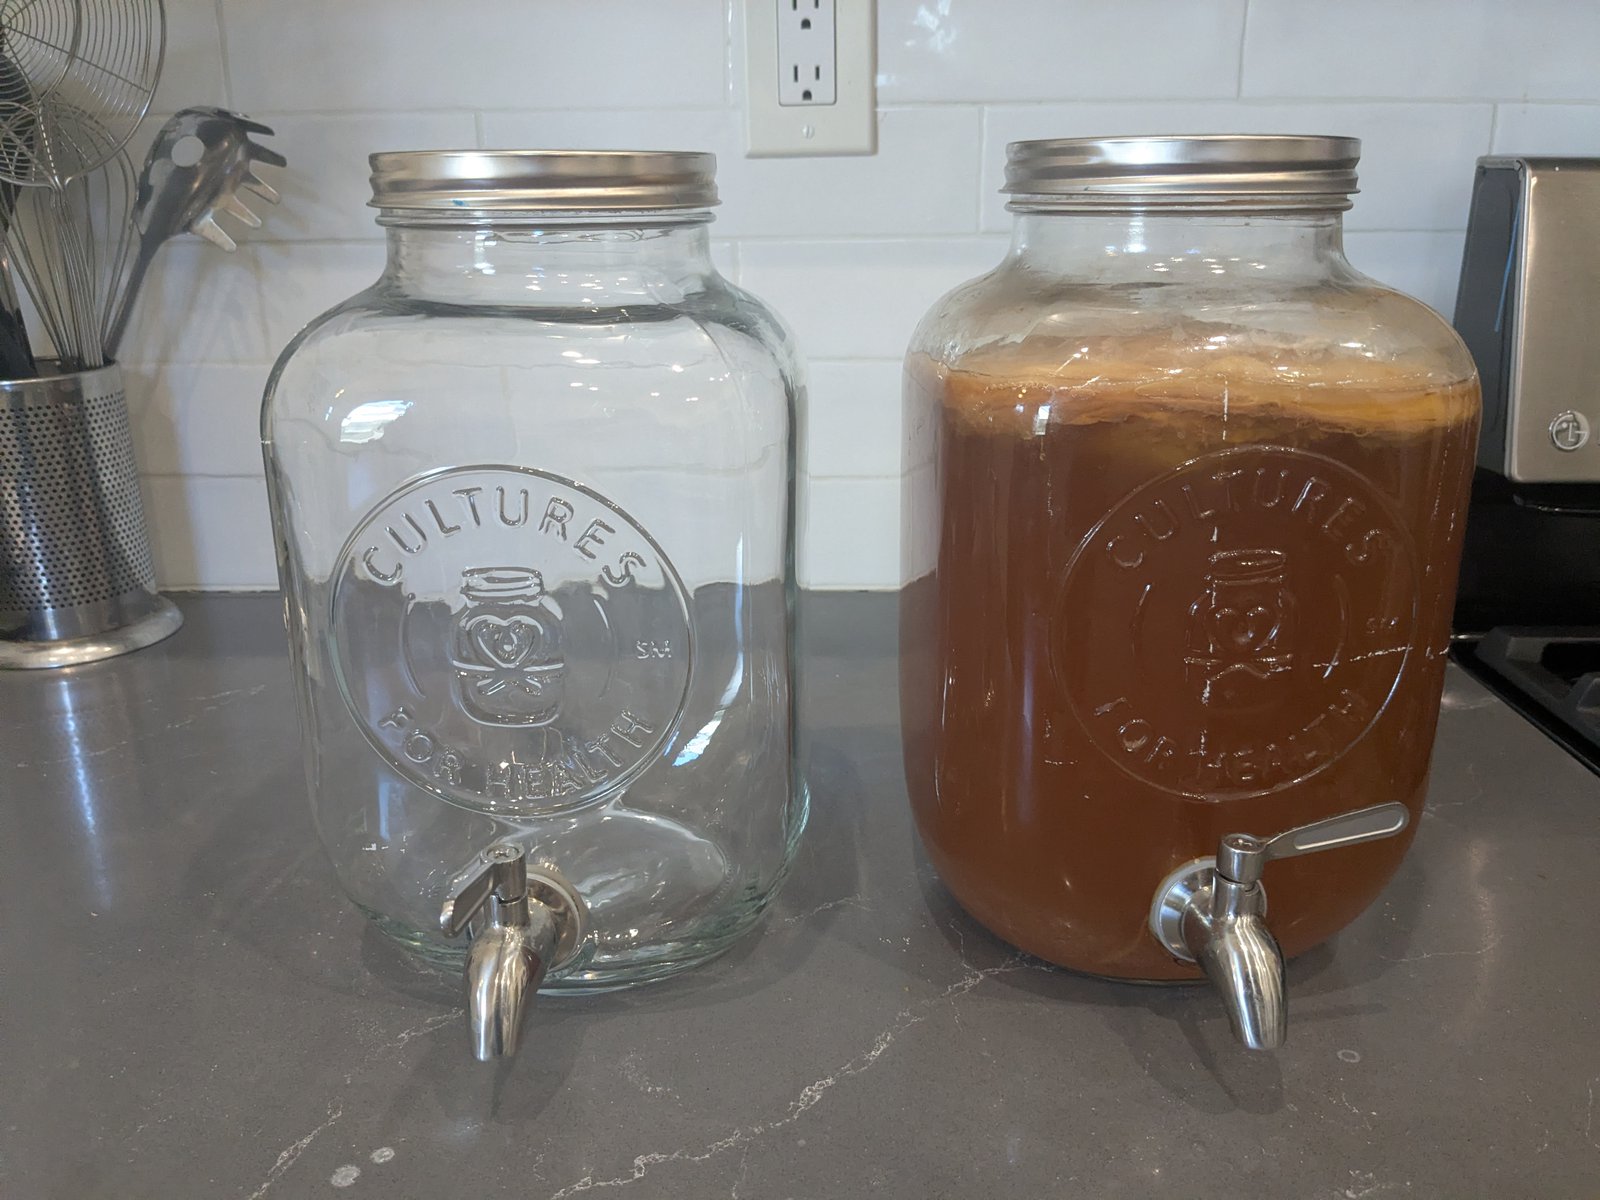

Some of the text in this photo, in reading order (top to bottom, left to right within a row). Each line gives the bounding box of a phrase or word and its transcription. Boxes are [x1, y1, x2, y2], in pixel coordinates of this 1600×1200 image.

[361, 486, 647, 588] CULTURES
[1106, 467, 1389, 569] CULTURES
[378, 707, 654, 800] FOR HEALTH
